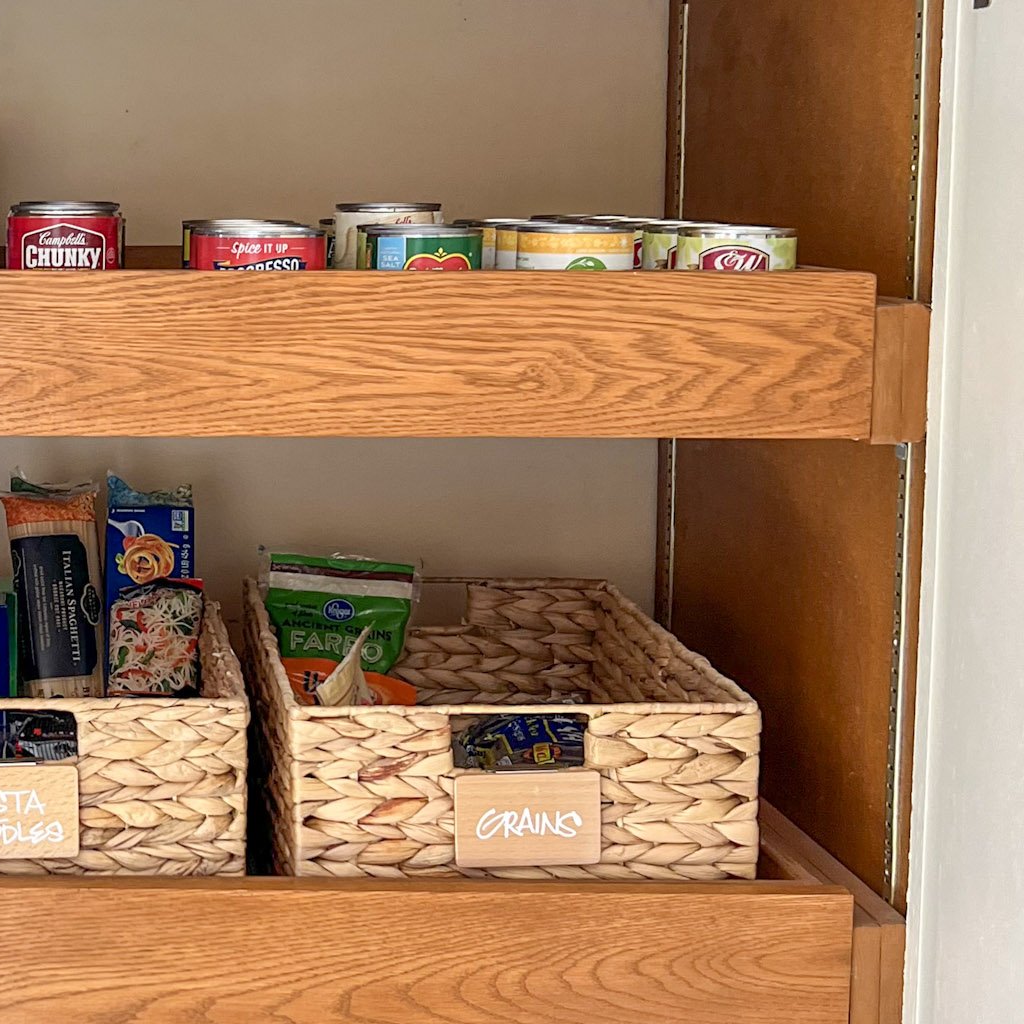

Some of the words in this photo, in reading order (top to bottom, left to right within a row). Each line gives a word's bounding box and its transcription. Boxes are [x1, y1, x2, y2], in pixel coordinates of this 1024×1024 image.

[39, 231, 86, 247] Campbell's
[26, 245, 101, 269] CHUNKY
[231, 241, 262, 259] Spice
[263, 244, 273, 253] IT
[275, 243, 288, 253] UP
[62, 551, 75, 596] ITALIAN
[328, 602, 351, 619] Kroger
[67, 599, 81, 661] SPAGHETTI
[281, 619, 340, 632] ANCIENT
[476, 807, 583, 840] GRAINS
